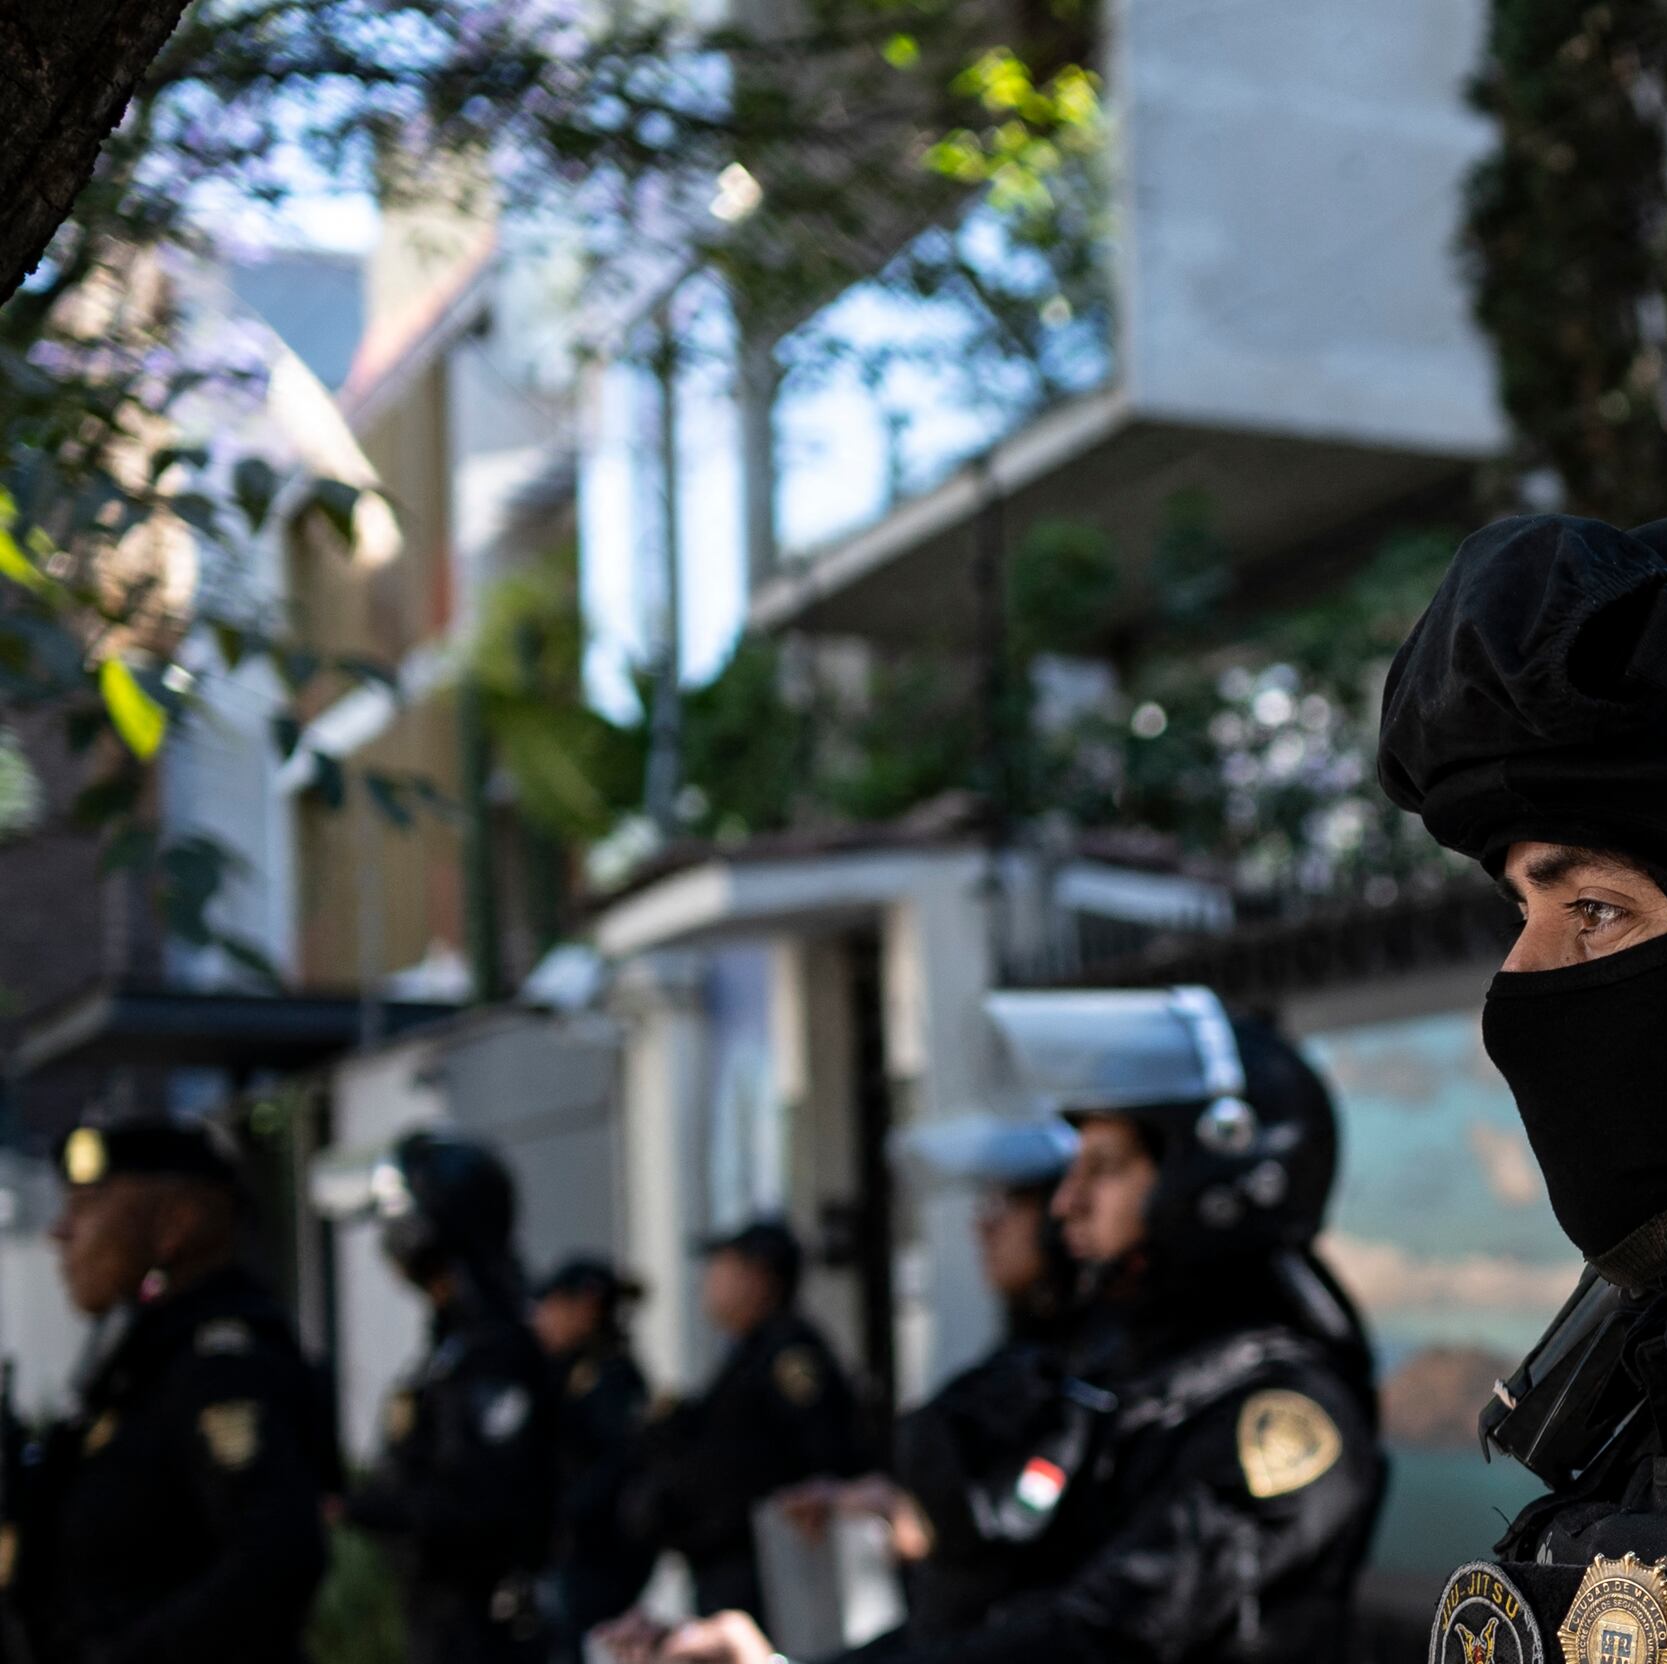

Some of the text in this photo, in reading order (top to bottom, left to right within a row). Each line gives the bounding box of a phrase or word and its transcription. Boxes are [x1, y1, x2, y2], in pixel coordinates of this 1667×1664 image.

[1442, 1573, 1520, 1630] JIU-JITSU
[1572, 1582, 1609, 1625] CIUDAD
[1614, 1581, 1630, 1594] DE
